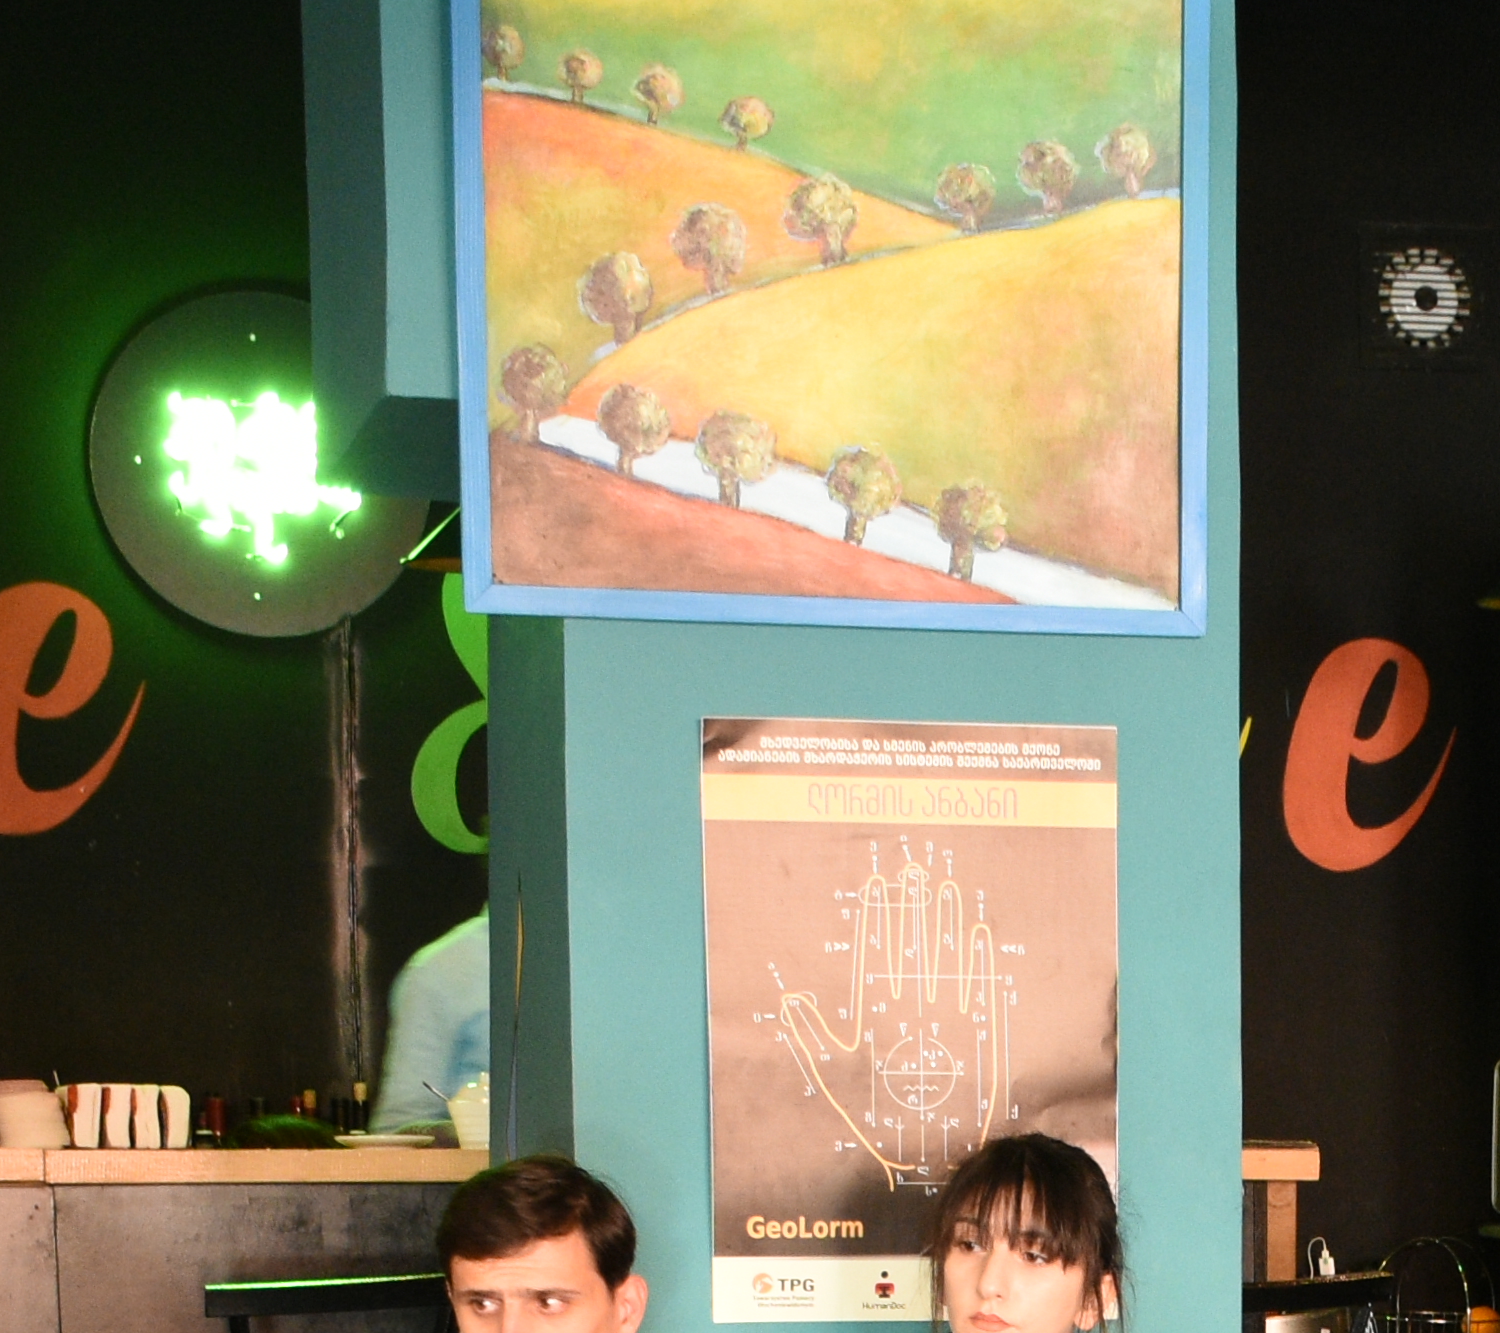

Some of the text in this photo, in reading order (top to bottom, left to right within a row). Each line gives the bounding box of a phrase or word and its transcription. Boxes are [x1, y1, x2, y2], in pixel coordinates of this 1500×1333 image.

[922, 785, 1018, 819] ანბანი
[746, 1215, 864, 1239] GeoLorm
[777, 1278, 815, 1292] TPG
[862, 1302, 906, 1310] HumanDoc
